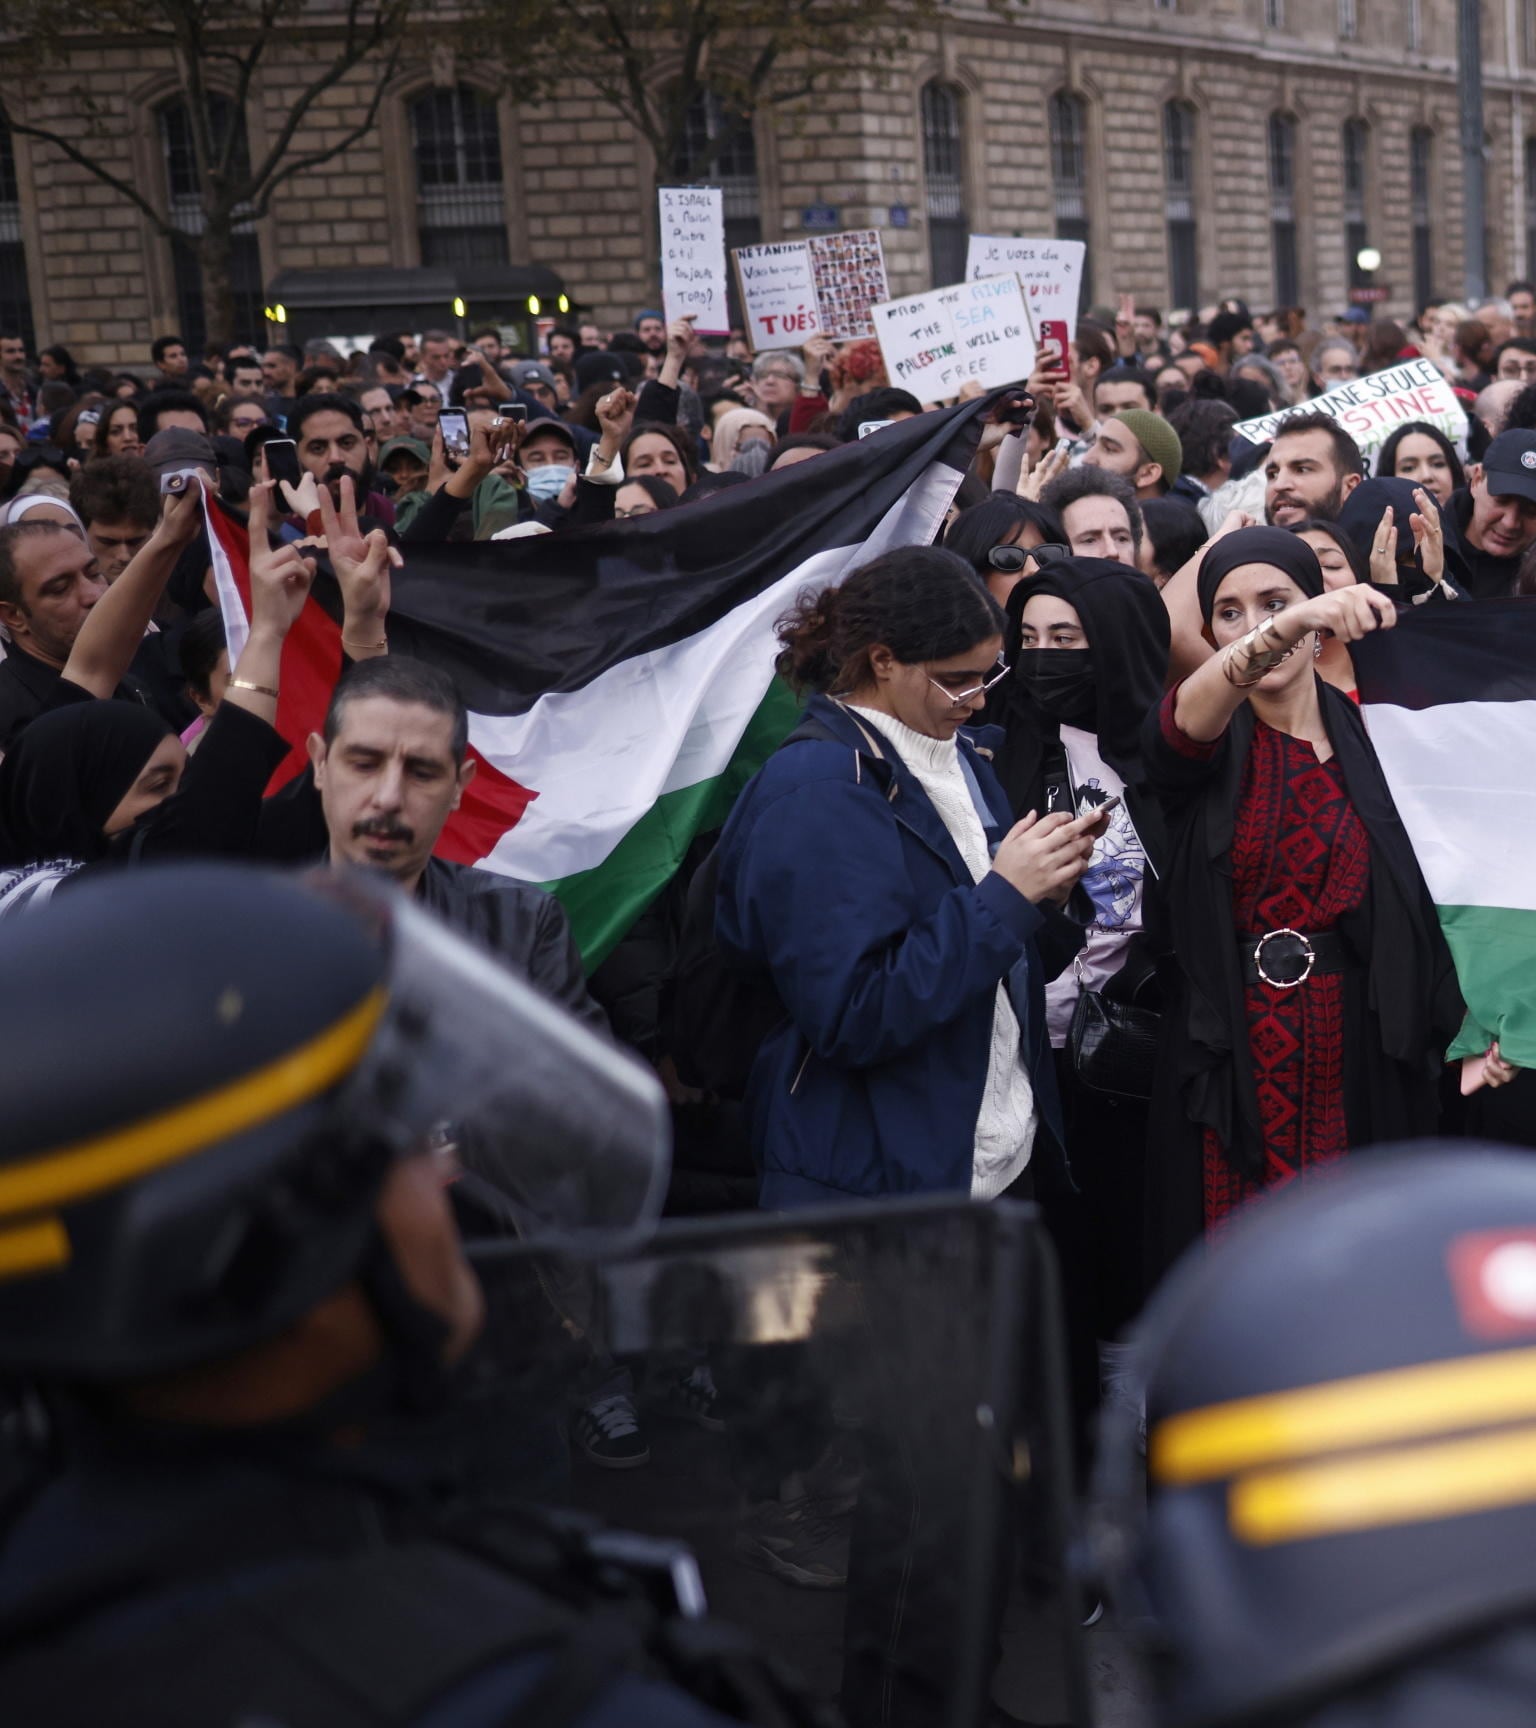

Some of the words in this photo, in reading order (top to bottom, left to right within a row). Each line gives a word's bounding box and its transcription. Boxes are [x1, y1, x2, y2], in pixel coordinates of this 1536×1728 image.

[938, 291, 960, 305] THE
[759, 304, 817, 335] TUÉS
[910, 321, 942, 341] THE
[955, 304, 995, 329] SEA
[895, 341, 957, 380] PALESTINE
[966, 328, 1001, 349] WILL
[940, 356, 988, 385] FREE
[1316, 383, 1368, 419] UNE
[1365, 360, 1441, 398] SEULE
[1343, 387, 1446, 434] STINE
